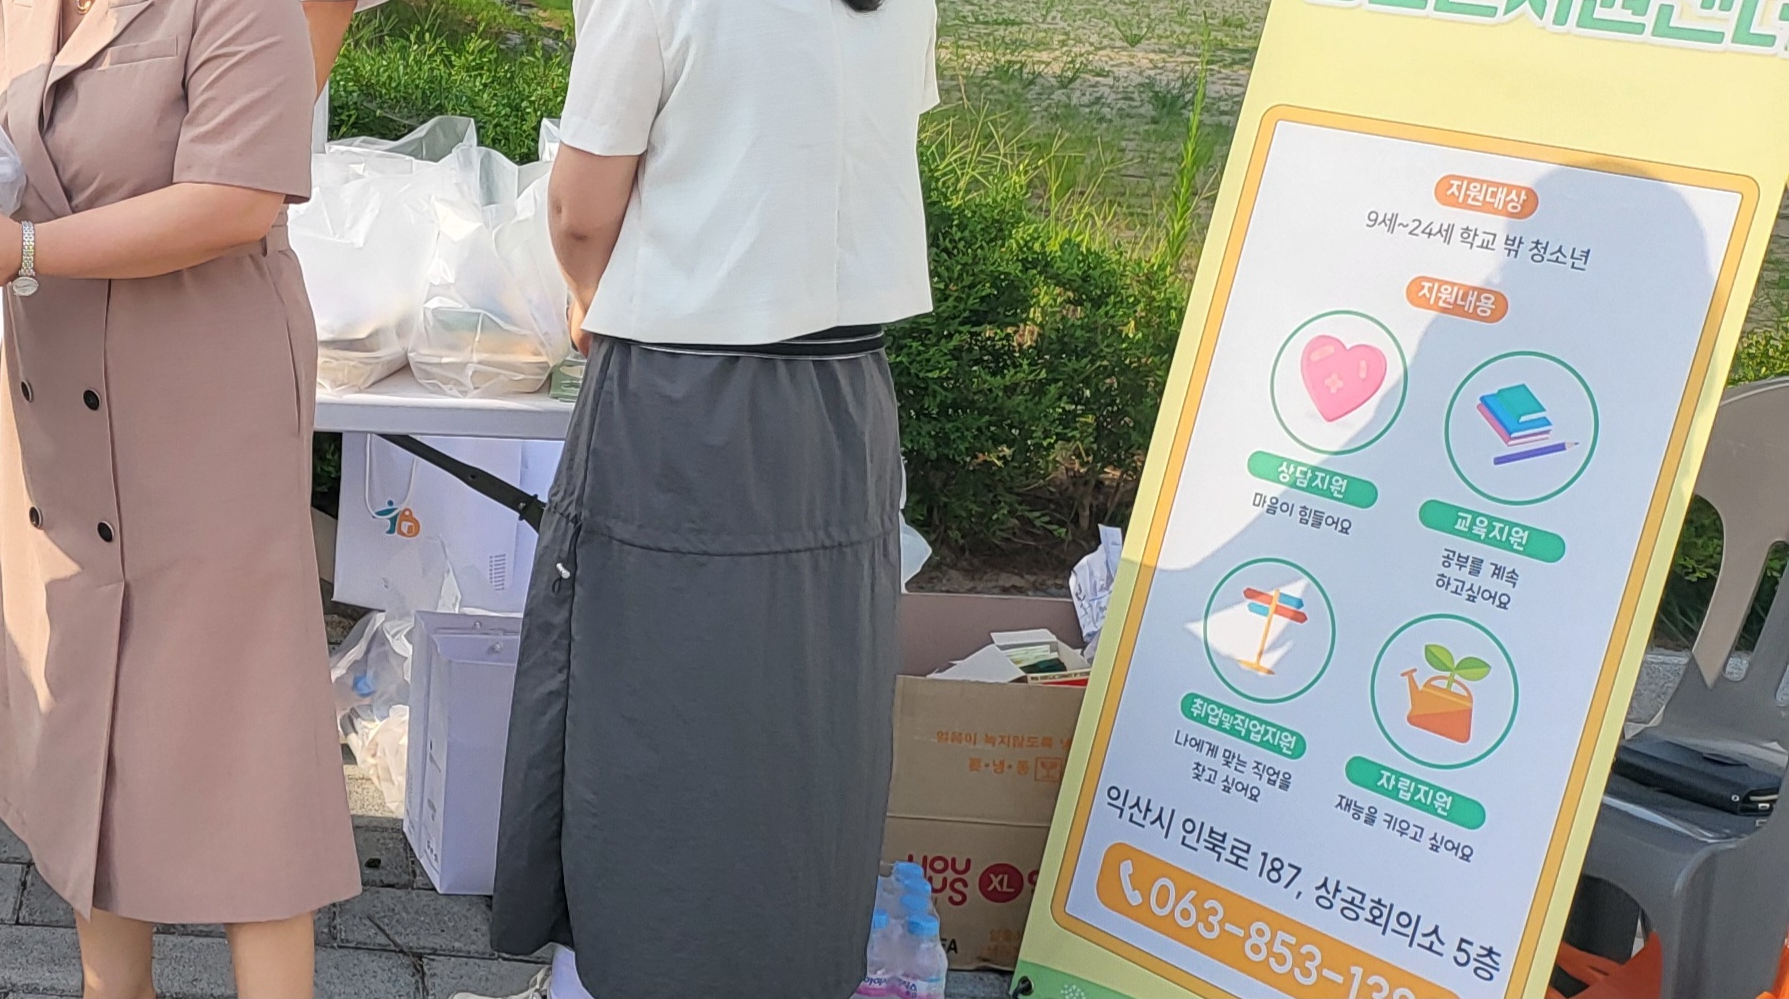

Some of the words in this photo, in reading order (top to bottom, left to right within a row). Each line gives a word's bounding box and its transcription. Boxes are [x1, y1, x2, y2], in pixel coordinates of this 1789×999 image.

[1445, 179, 1528, 215] 지원대상
[1365, 209, 1456, 246] 9세~24세
[1459, 226, 1498, 253] 학교
[1503, 234, 1524, 260] 밖
[1528, 239, 1592, 272] 청소년
[1417, 280, 1497, 318] 지원내용
[1277, 460, 1348, 500] 상담지원
[1252, 492, 1295, 518] 마음이
[1298, 506, 1353, 536] 힘들어요
[1454, 512, 1529, 552] 교육지원
[1441, 548, 1484, 577] 공부를
[1488, 562, 1520, 589] 계속
[1435, 573, 1512, 611] 하고싶어요
[1174, 729, 1220, 761] 나에게
[1222, 746, 1248, 775] 맞는
[1251, 759, 1294, 793] 직업을
[1191, 761, 1218, 787] 찾고
[1221, 773, 1262, 803] 싶어요
[1376, 768, 1454, 816] 자립지원
[1334, 795, 1378, 829] 재능을
[1382, 811, 1425, 843] 키우고
[1428, 831, 1475, 864] 싶어요
[986, 873, 1016, 893] XL
[1106, 785, 1177, 839] 익산시
[1181, 818, 1252, 872] 인북로
[1258, 851, 1303, 900] 187,
[1314, 876, 1447, 958] 상공회의소
[1452, 939, 1502, 982] 5층
